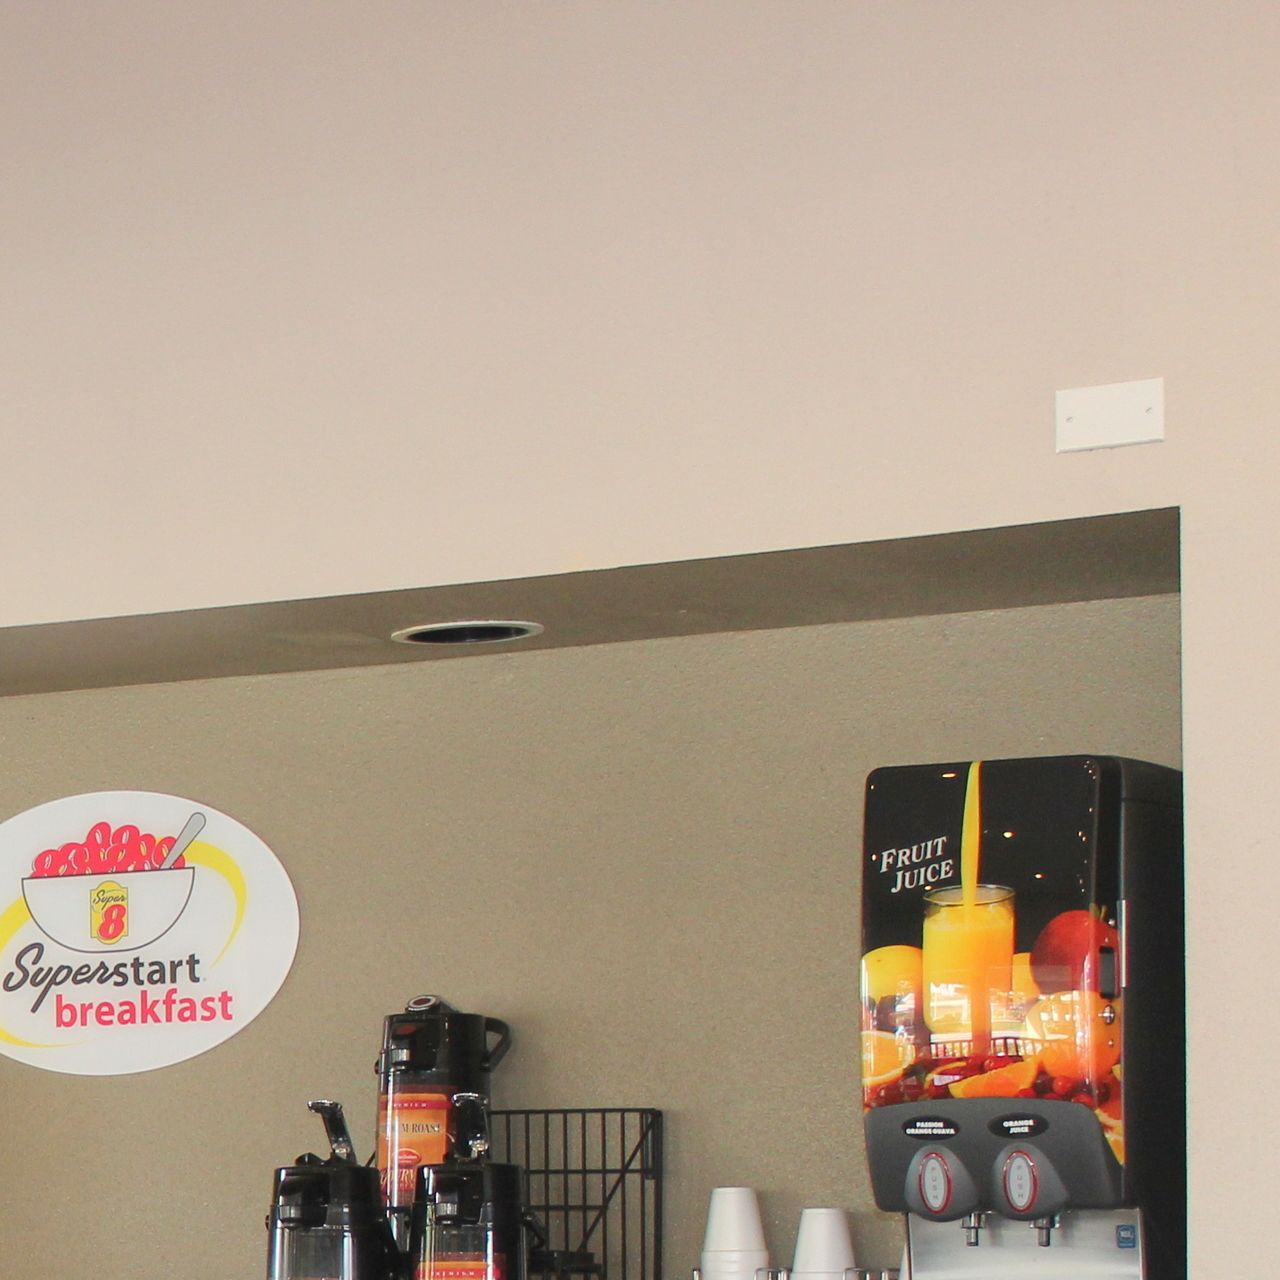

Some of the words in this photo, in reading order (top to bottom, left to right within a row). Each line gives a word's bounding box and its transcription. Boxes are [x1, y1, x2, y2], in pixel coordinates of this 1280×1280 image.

[880, 836, 947, 873] FRUIT
[890, 859, 954, 893] JUICE
[92, 889, 126, 909] Super
[98, 904, 127, 939] 8
[2, 942, 201, 1014] Superstart
[55, 987, 234, 1028] breakfast
[1003, 1119, 1034, 1128] ORANGE
[1009, 1126, 1029, 1134] JUICE
